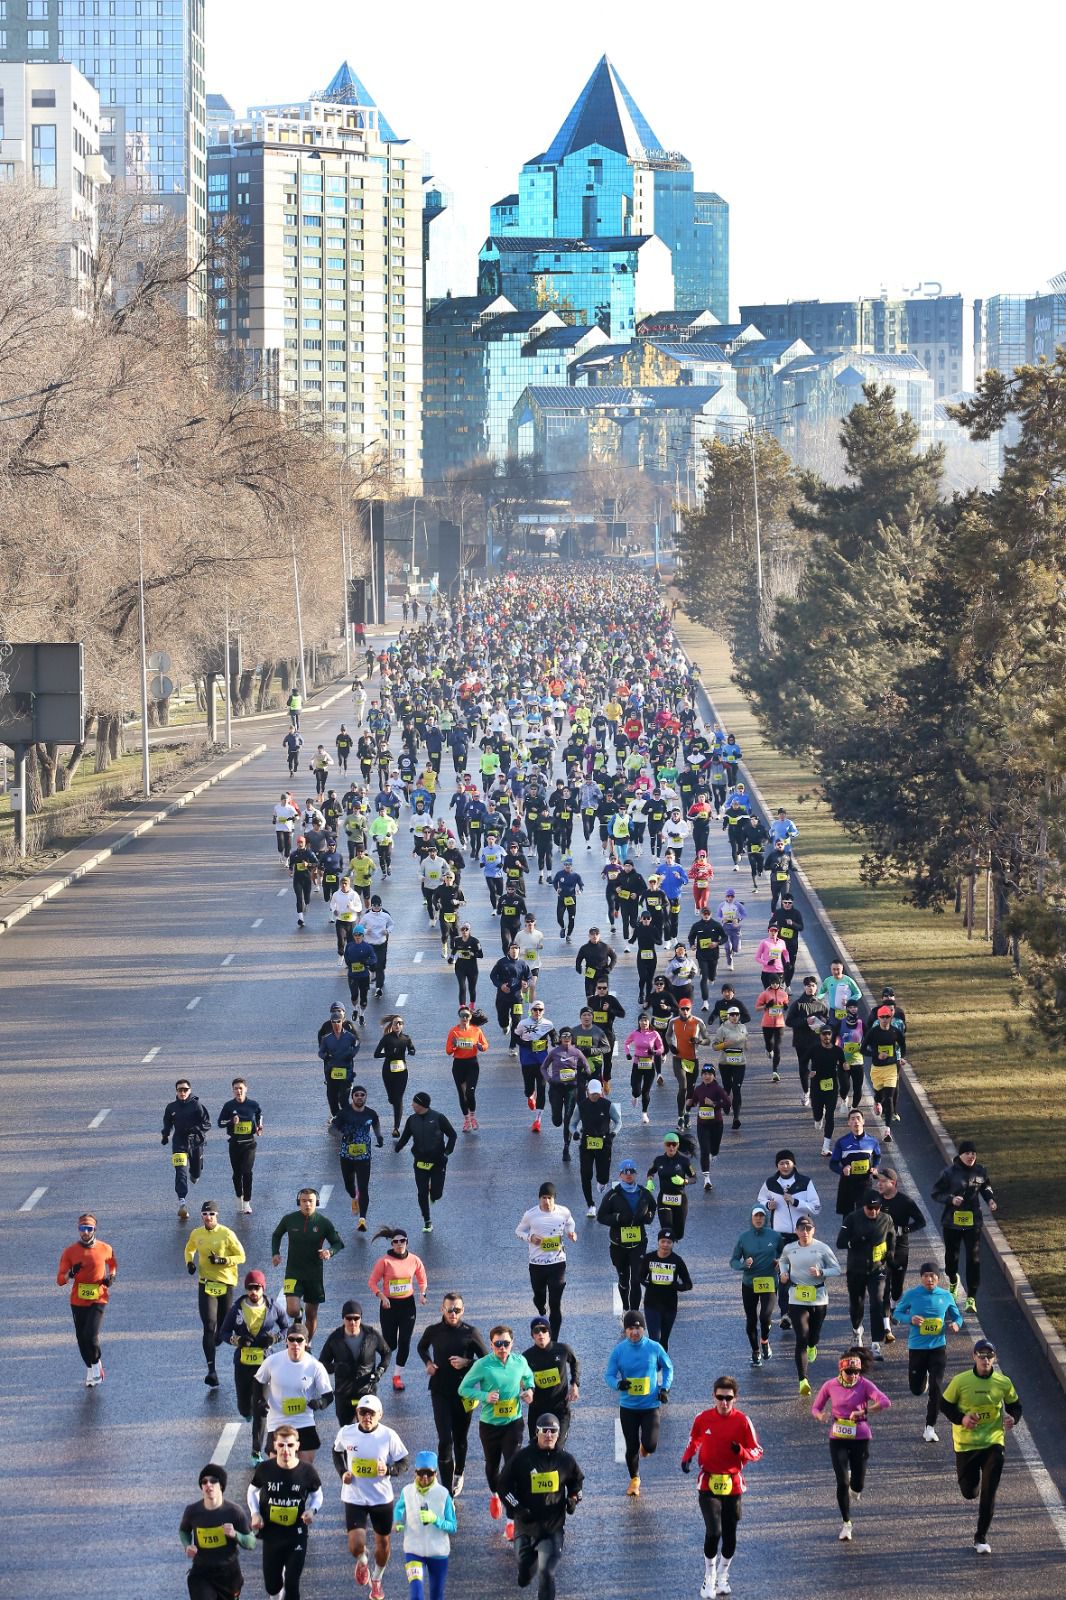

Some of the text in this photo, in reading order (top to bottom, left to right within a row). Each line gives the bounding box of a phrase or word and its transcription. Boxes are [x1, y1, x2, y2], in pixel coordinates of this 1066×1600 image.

[925, 1324, 938, 1332] 457
[537, 1480, 553, 1488] 740
[713, 1482, 728, 1490] 872
[280, 1514, 288, 1522] 18
